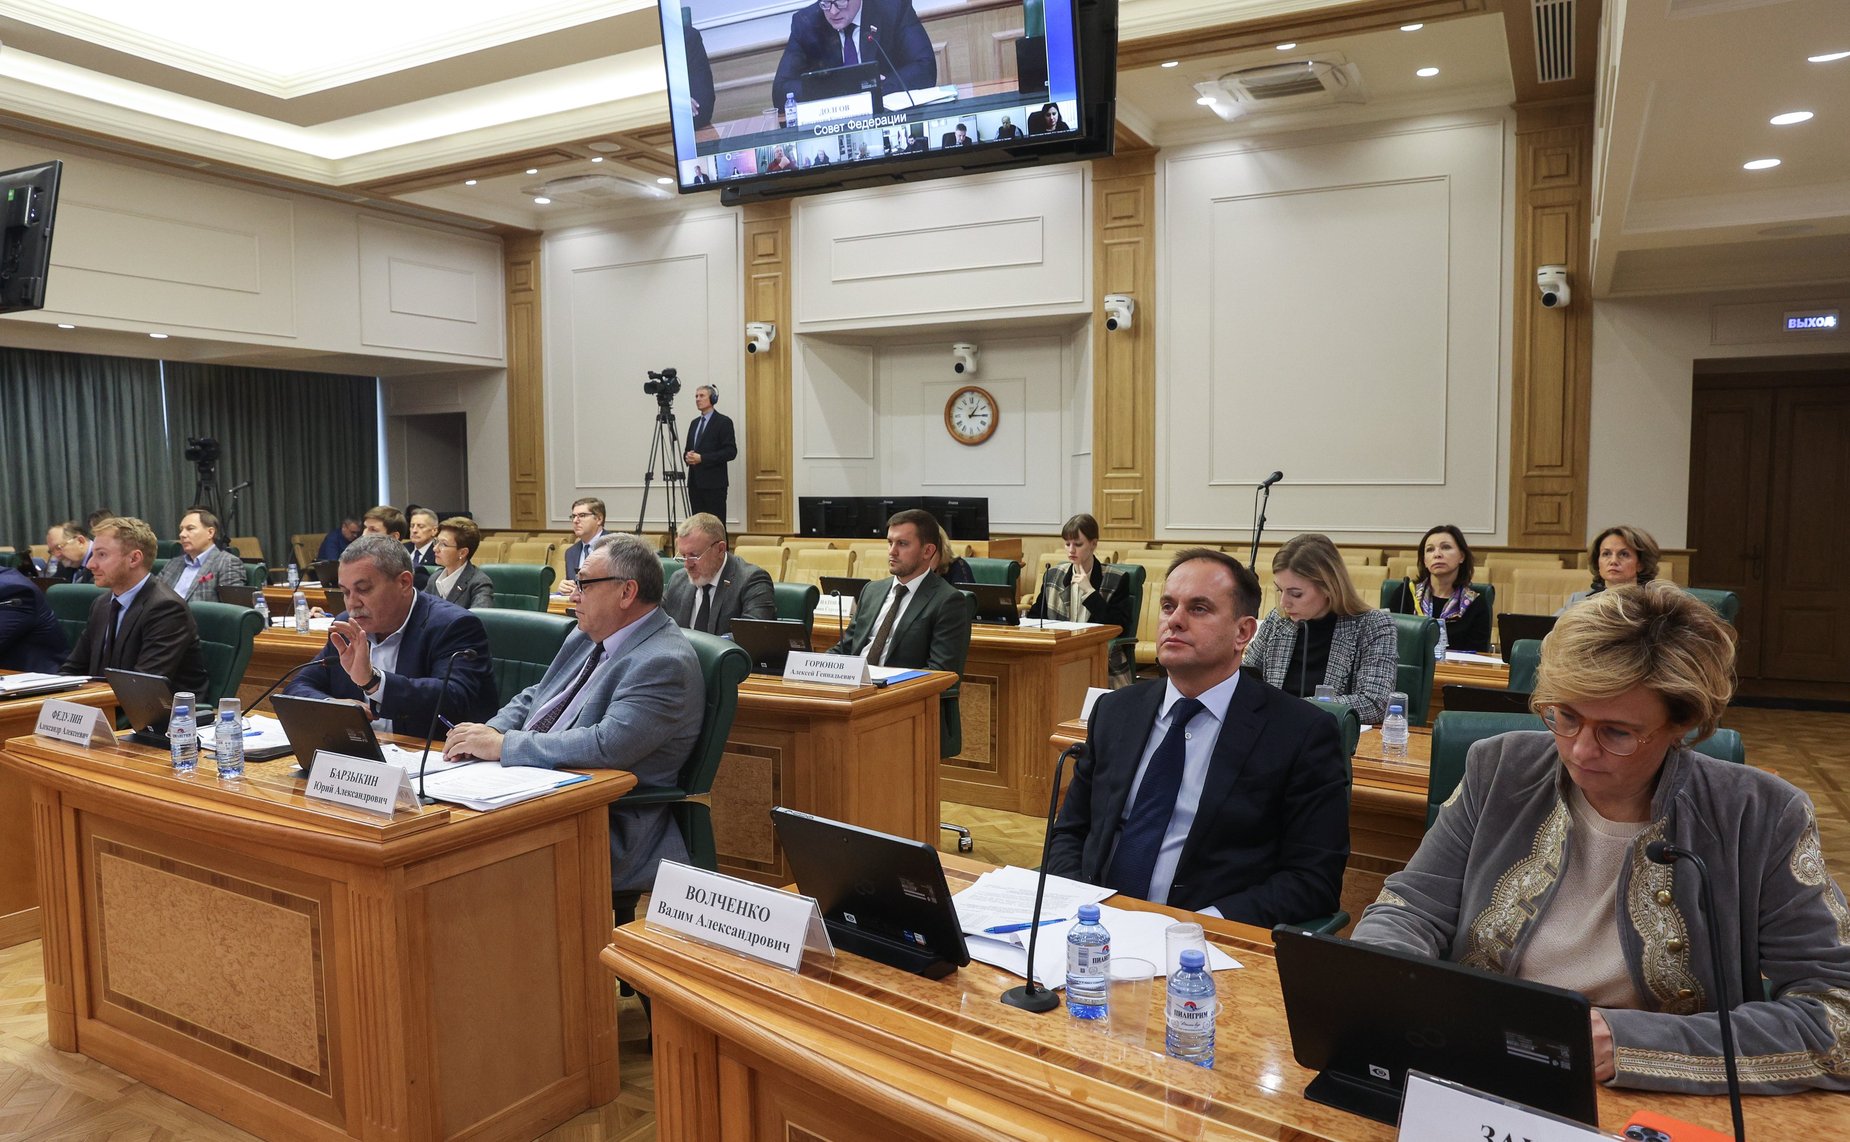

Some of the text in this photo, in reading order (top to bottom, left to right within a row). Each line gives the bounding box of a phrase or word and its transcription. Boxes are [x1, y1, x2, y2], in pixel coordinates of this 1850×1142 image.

[813, 123, 845, 136] Совет
[847, 113, 907, 131] Федерации
[1788, 316, 1834, 329] ВЫХОД
[790, 669, 815, 678] Алексей
[804, 659, 845, 670] ГОРЮНОВ
[51, 710, 84, 725] ФЕДУЛИН
[39, 722, 89, 739] Александр Алексеевич
[329, 767, 379, 787] БАРЗЫКИН
[313, 780, 334, 794] Юрий
[334, 786, 388, 805] Александрович
[685, 885, 771, 923] ВОЛЧЕНКО
[657, 901, 791, 954] Вадим Александрович
